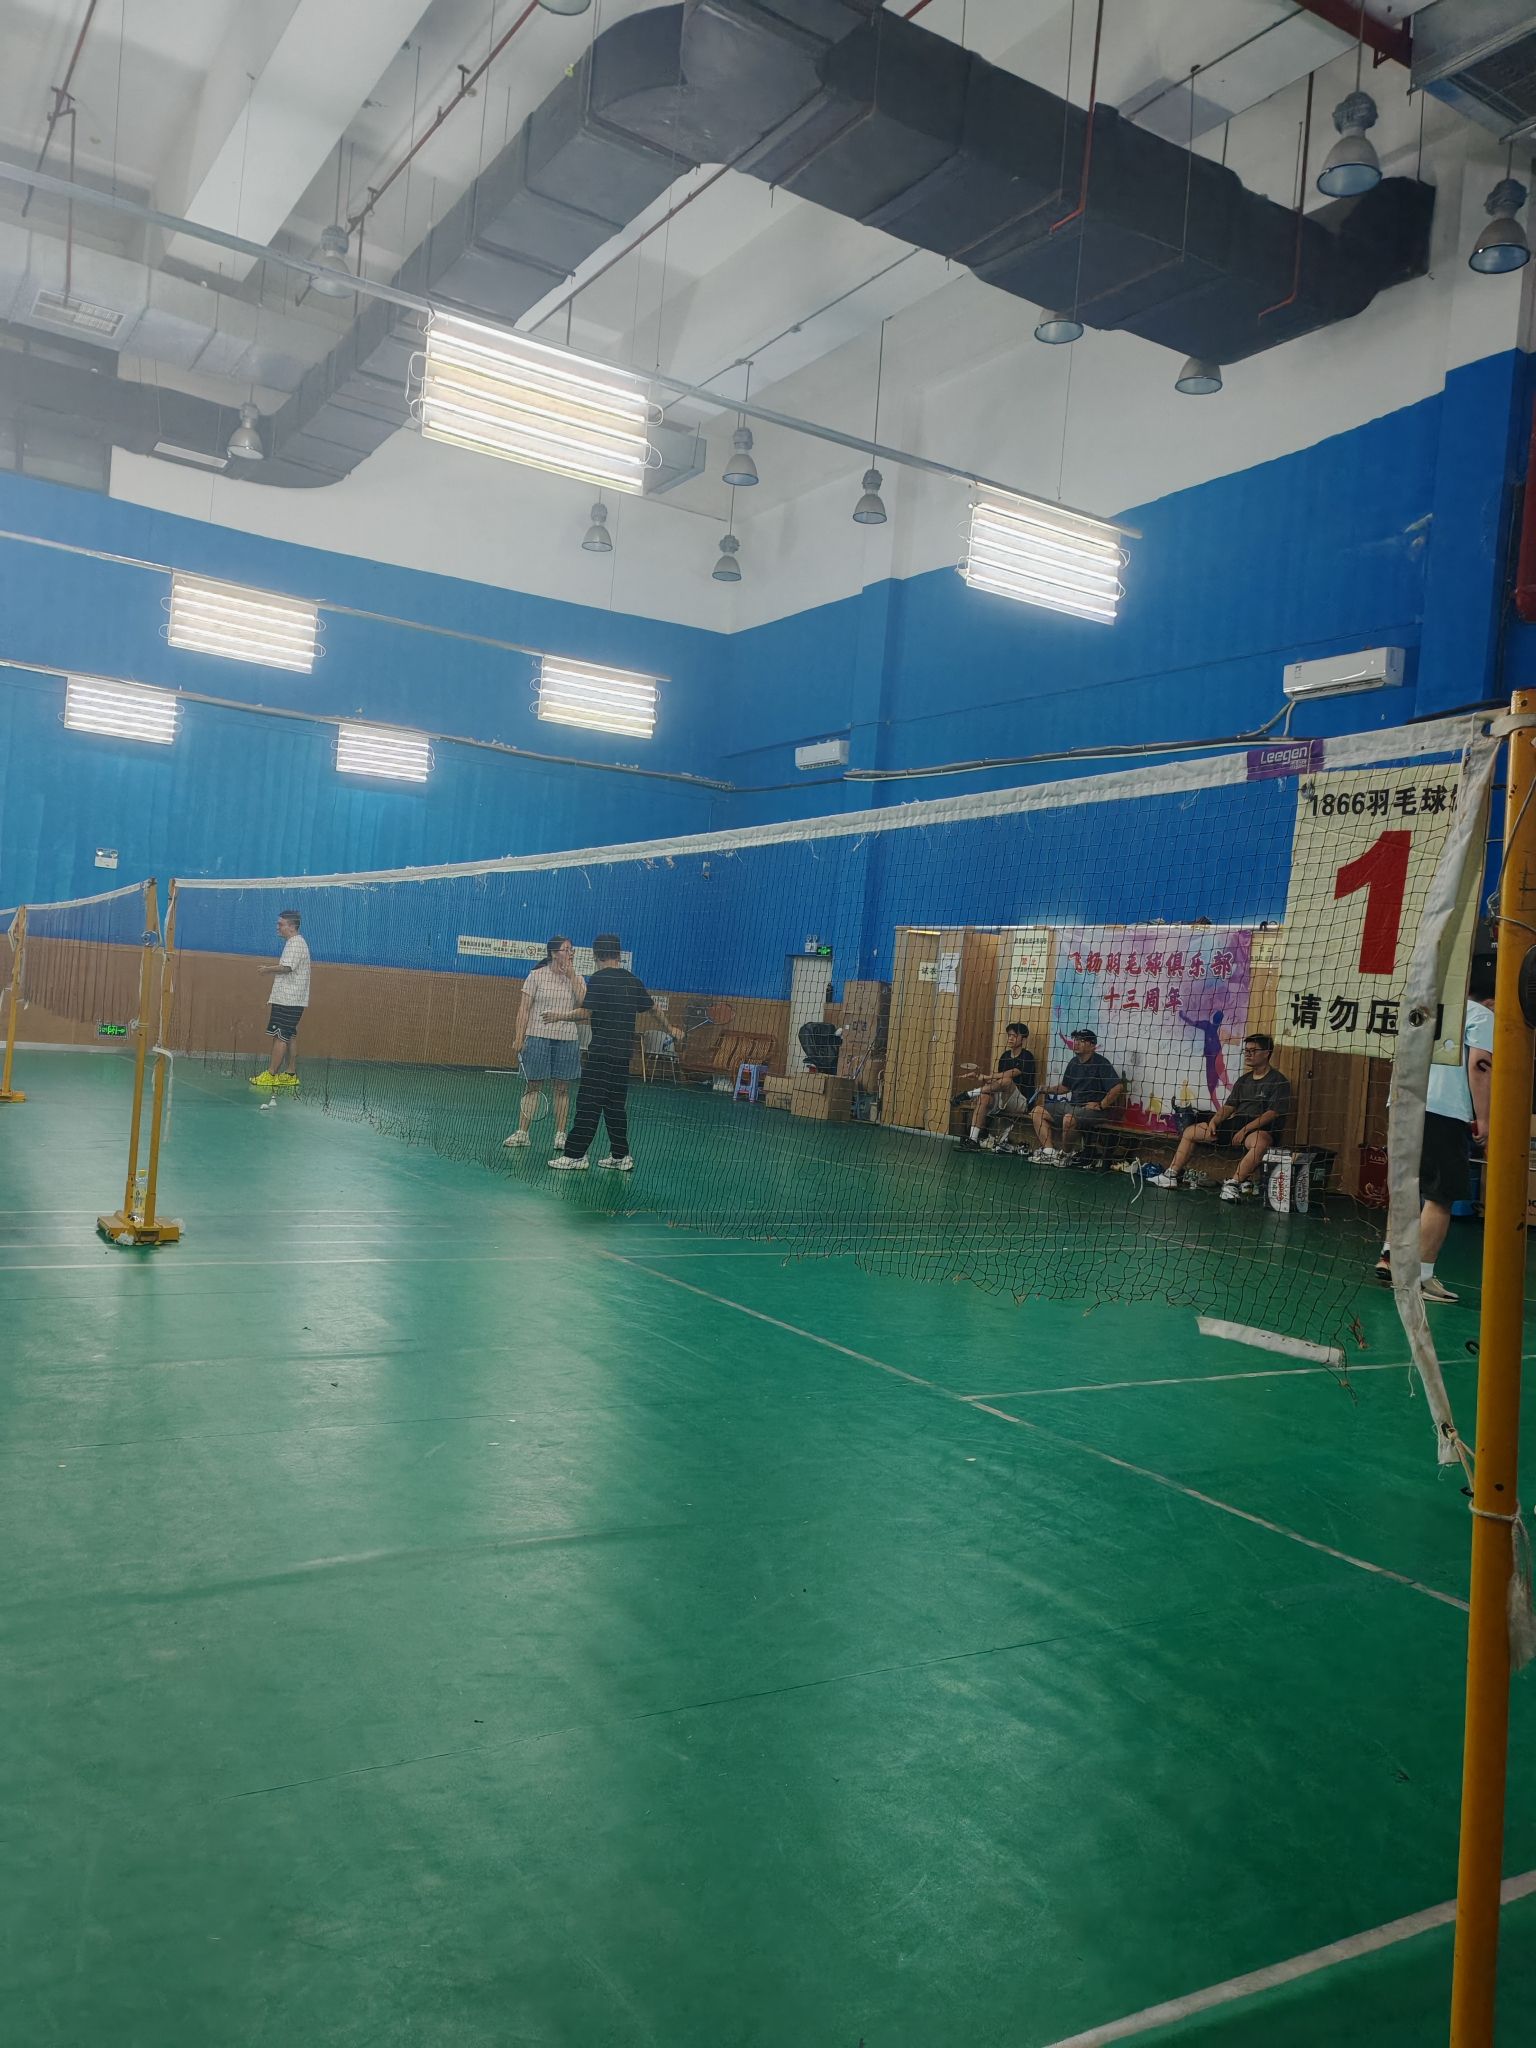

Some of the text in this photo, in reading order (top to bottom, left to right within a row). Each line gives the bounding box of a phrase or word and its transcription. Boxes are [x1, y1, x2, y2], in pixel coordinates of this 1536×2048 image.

[1261, 747, 1307, 764] Leegen
[1334, 830, 1412, 975] 1
[1069, 950, 1234, 981] 飞扬羽毛球俱乐部
[1103, 986, 1183, 1015] 十三周年
[1290, 993, 1444, 1041] 请勿压
